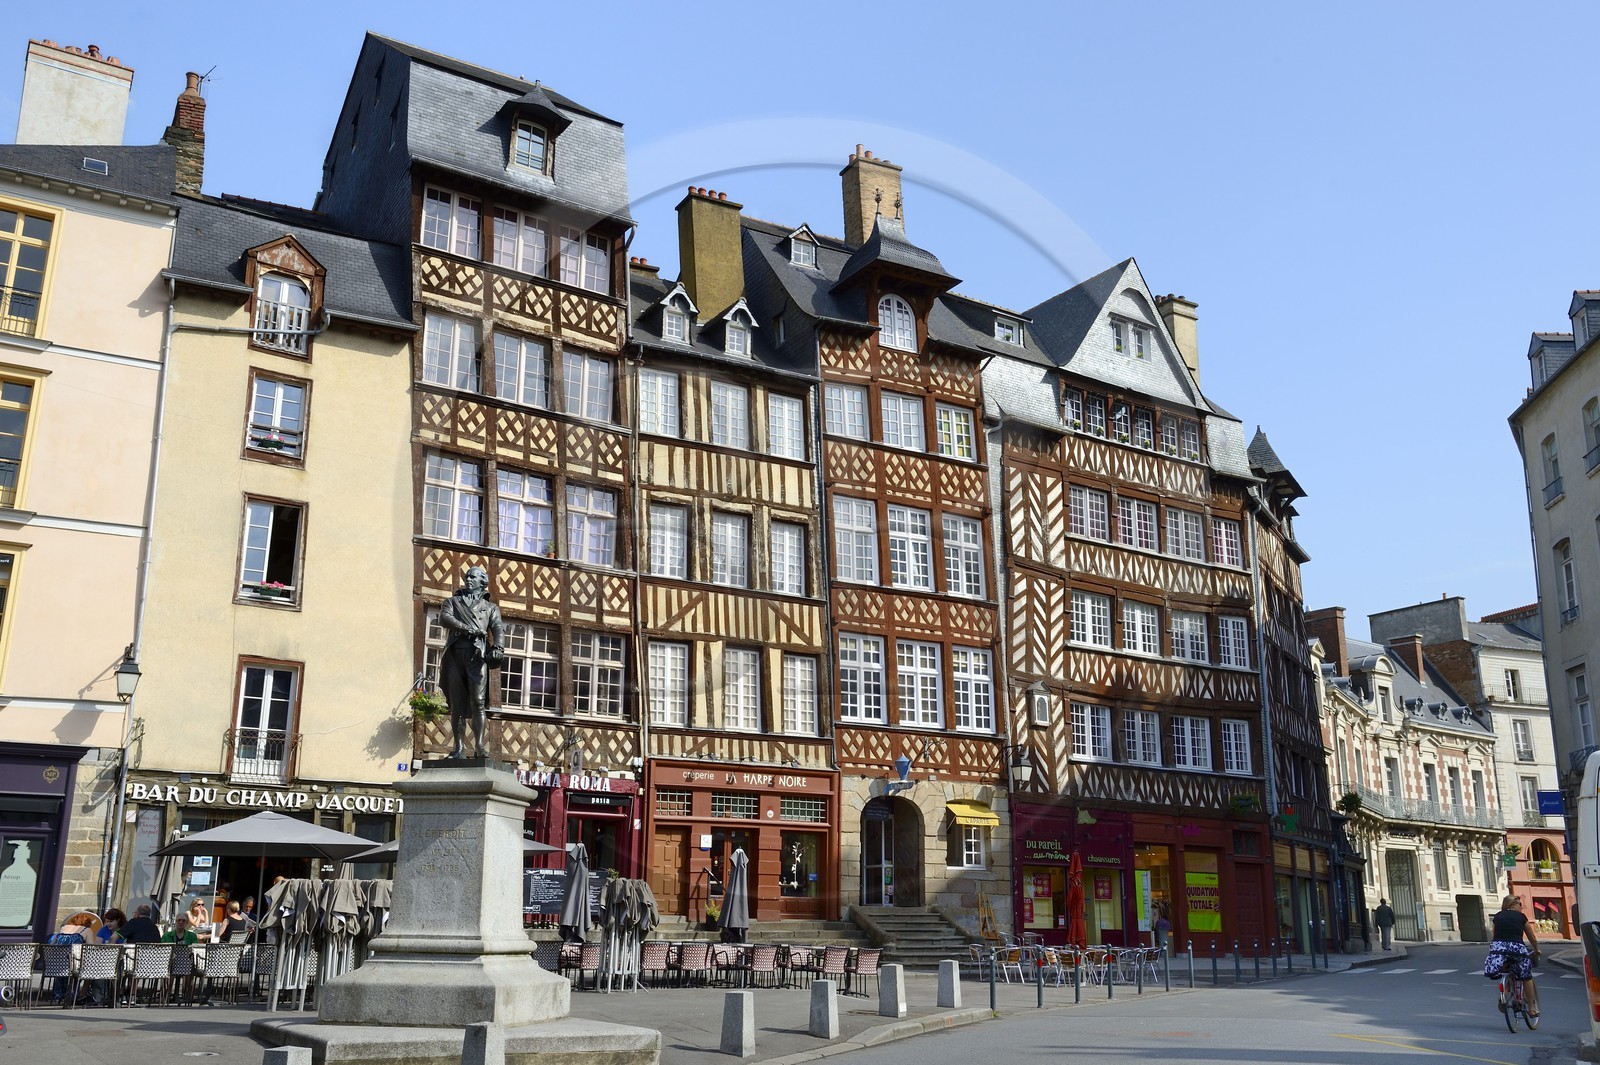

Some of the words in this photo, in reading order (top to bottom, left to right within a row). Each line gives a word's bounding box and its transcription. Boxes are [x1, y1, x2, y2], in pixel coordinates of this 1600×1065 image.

[400, 763, 406, 771] 9
[514, 769, 561, 788] AMMA
[569, 774, 611, 792] ROMA
[725, 772, 737, 784] LA
[743, 773, 773, 785] HARPE
[778, 775, 807, 788] NOIRE
[131, 783, 180, 804] BAR
[188, 786, 218, 804] DU
[226, 789, 308, 809] CHAMP
[1087, 854, 1121, 864] chaussures
[1189, 899, 1213, 909] TOTALE
